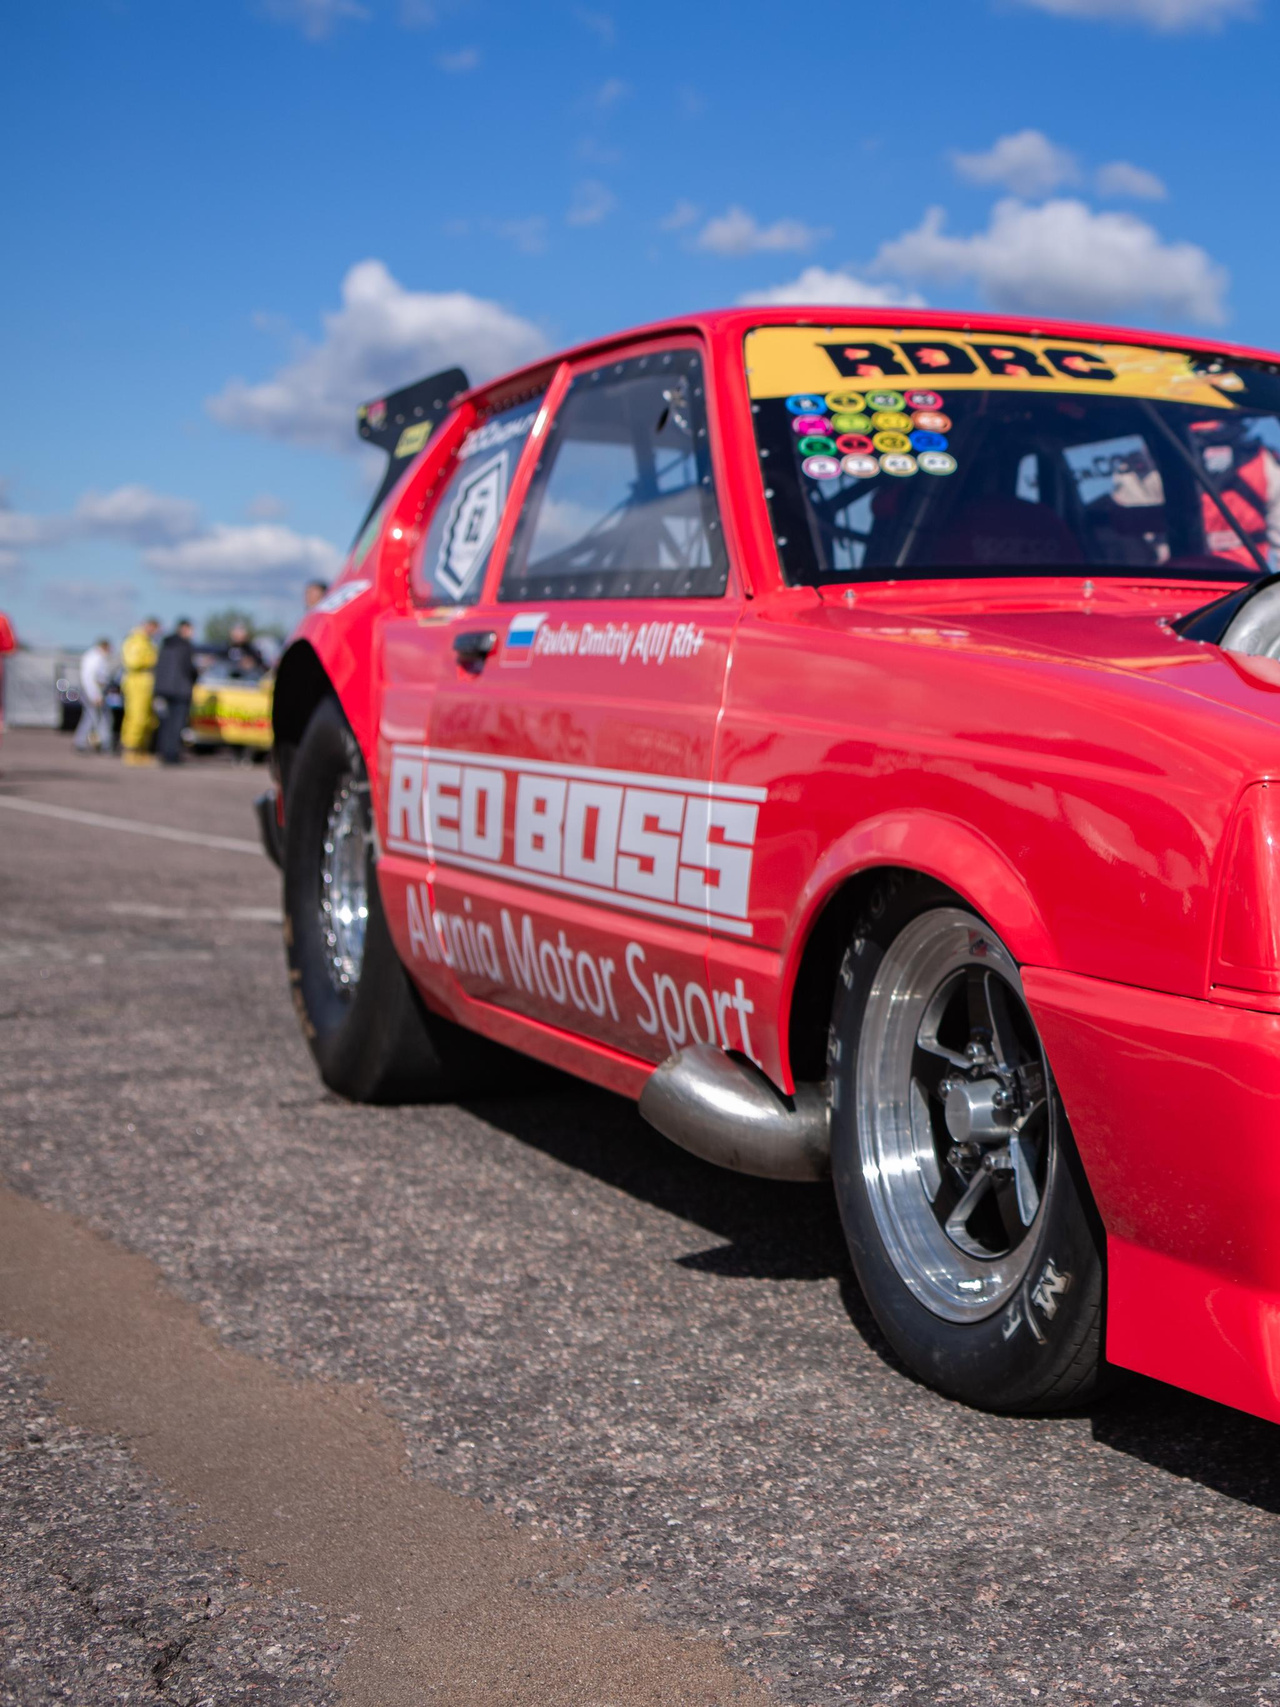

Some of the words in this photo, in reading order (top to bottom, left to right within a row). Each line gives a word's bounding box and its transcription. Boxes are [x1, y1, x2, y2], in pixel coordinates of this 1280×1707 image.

[816, 341, 1117, 381] RDRC
[535, 621, 579, 656] Pavlov
[578, 621, 634, 665] Dmitriy
[389, 758, 505, 862] RED
[514, 773, 760, 918] BOSS
[406, 884, 505, 984] Alania
[501, 908, 620, 1023] Motor
[625, 942, 755, 1069] Sport
